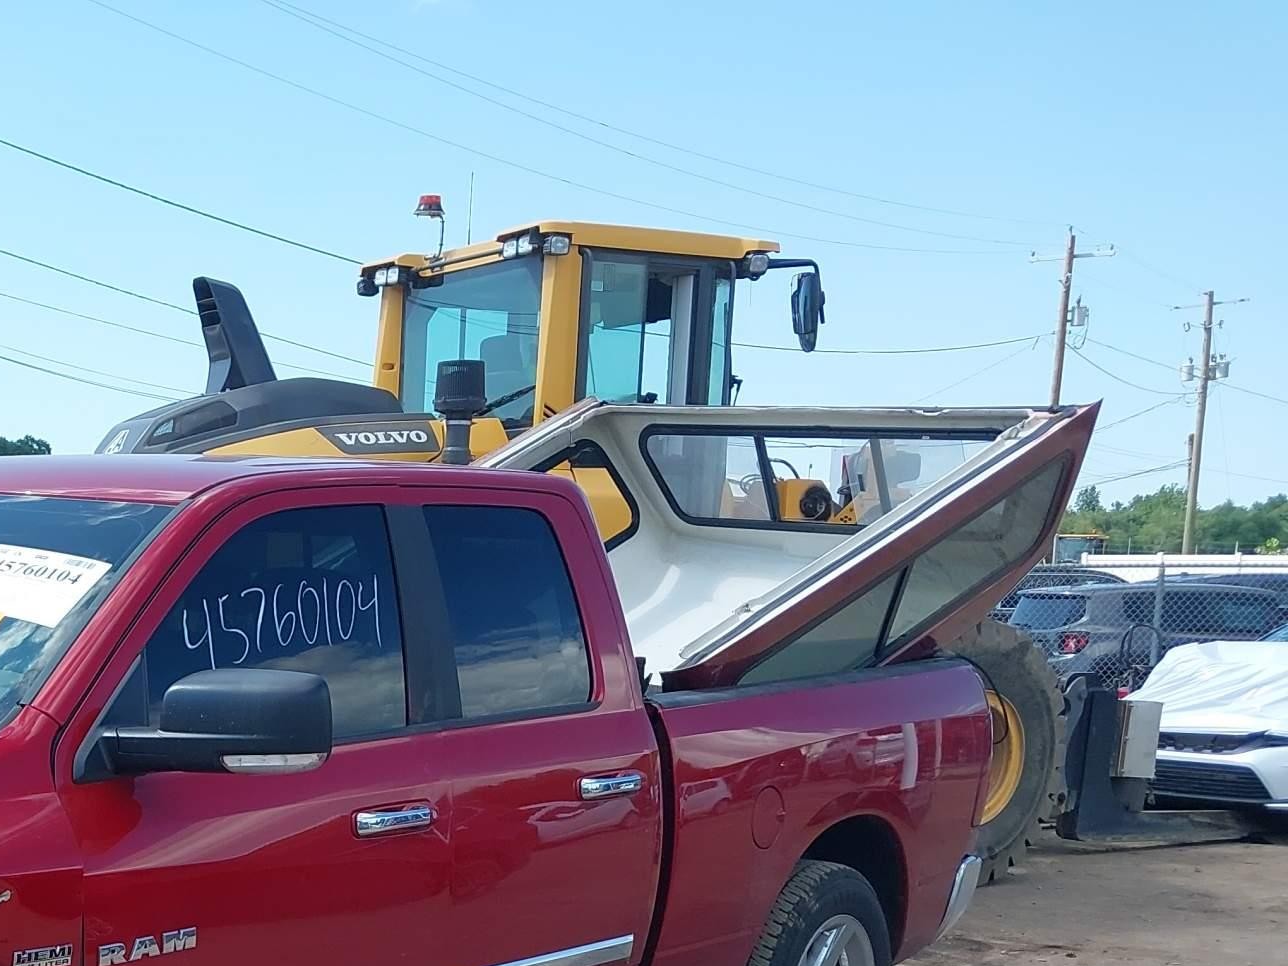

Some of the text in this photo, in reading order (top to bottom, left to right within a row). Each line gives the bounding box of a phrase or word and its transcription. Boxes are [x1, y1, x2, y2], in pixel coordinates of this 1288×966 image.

[334, 429, 428, 446] VOLVO
[182, 573, 383, 671] 45760104
[15, 945, 73, 964] HEMI
